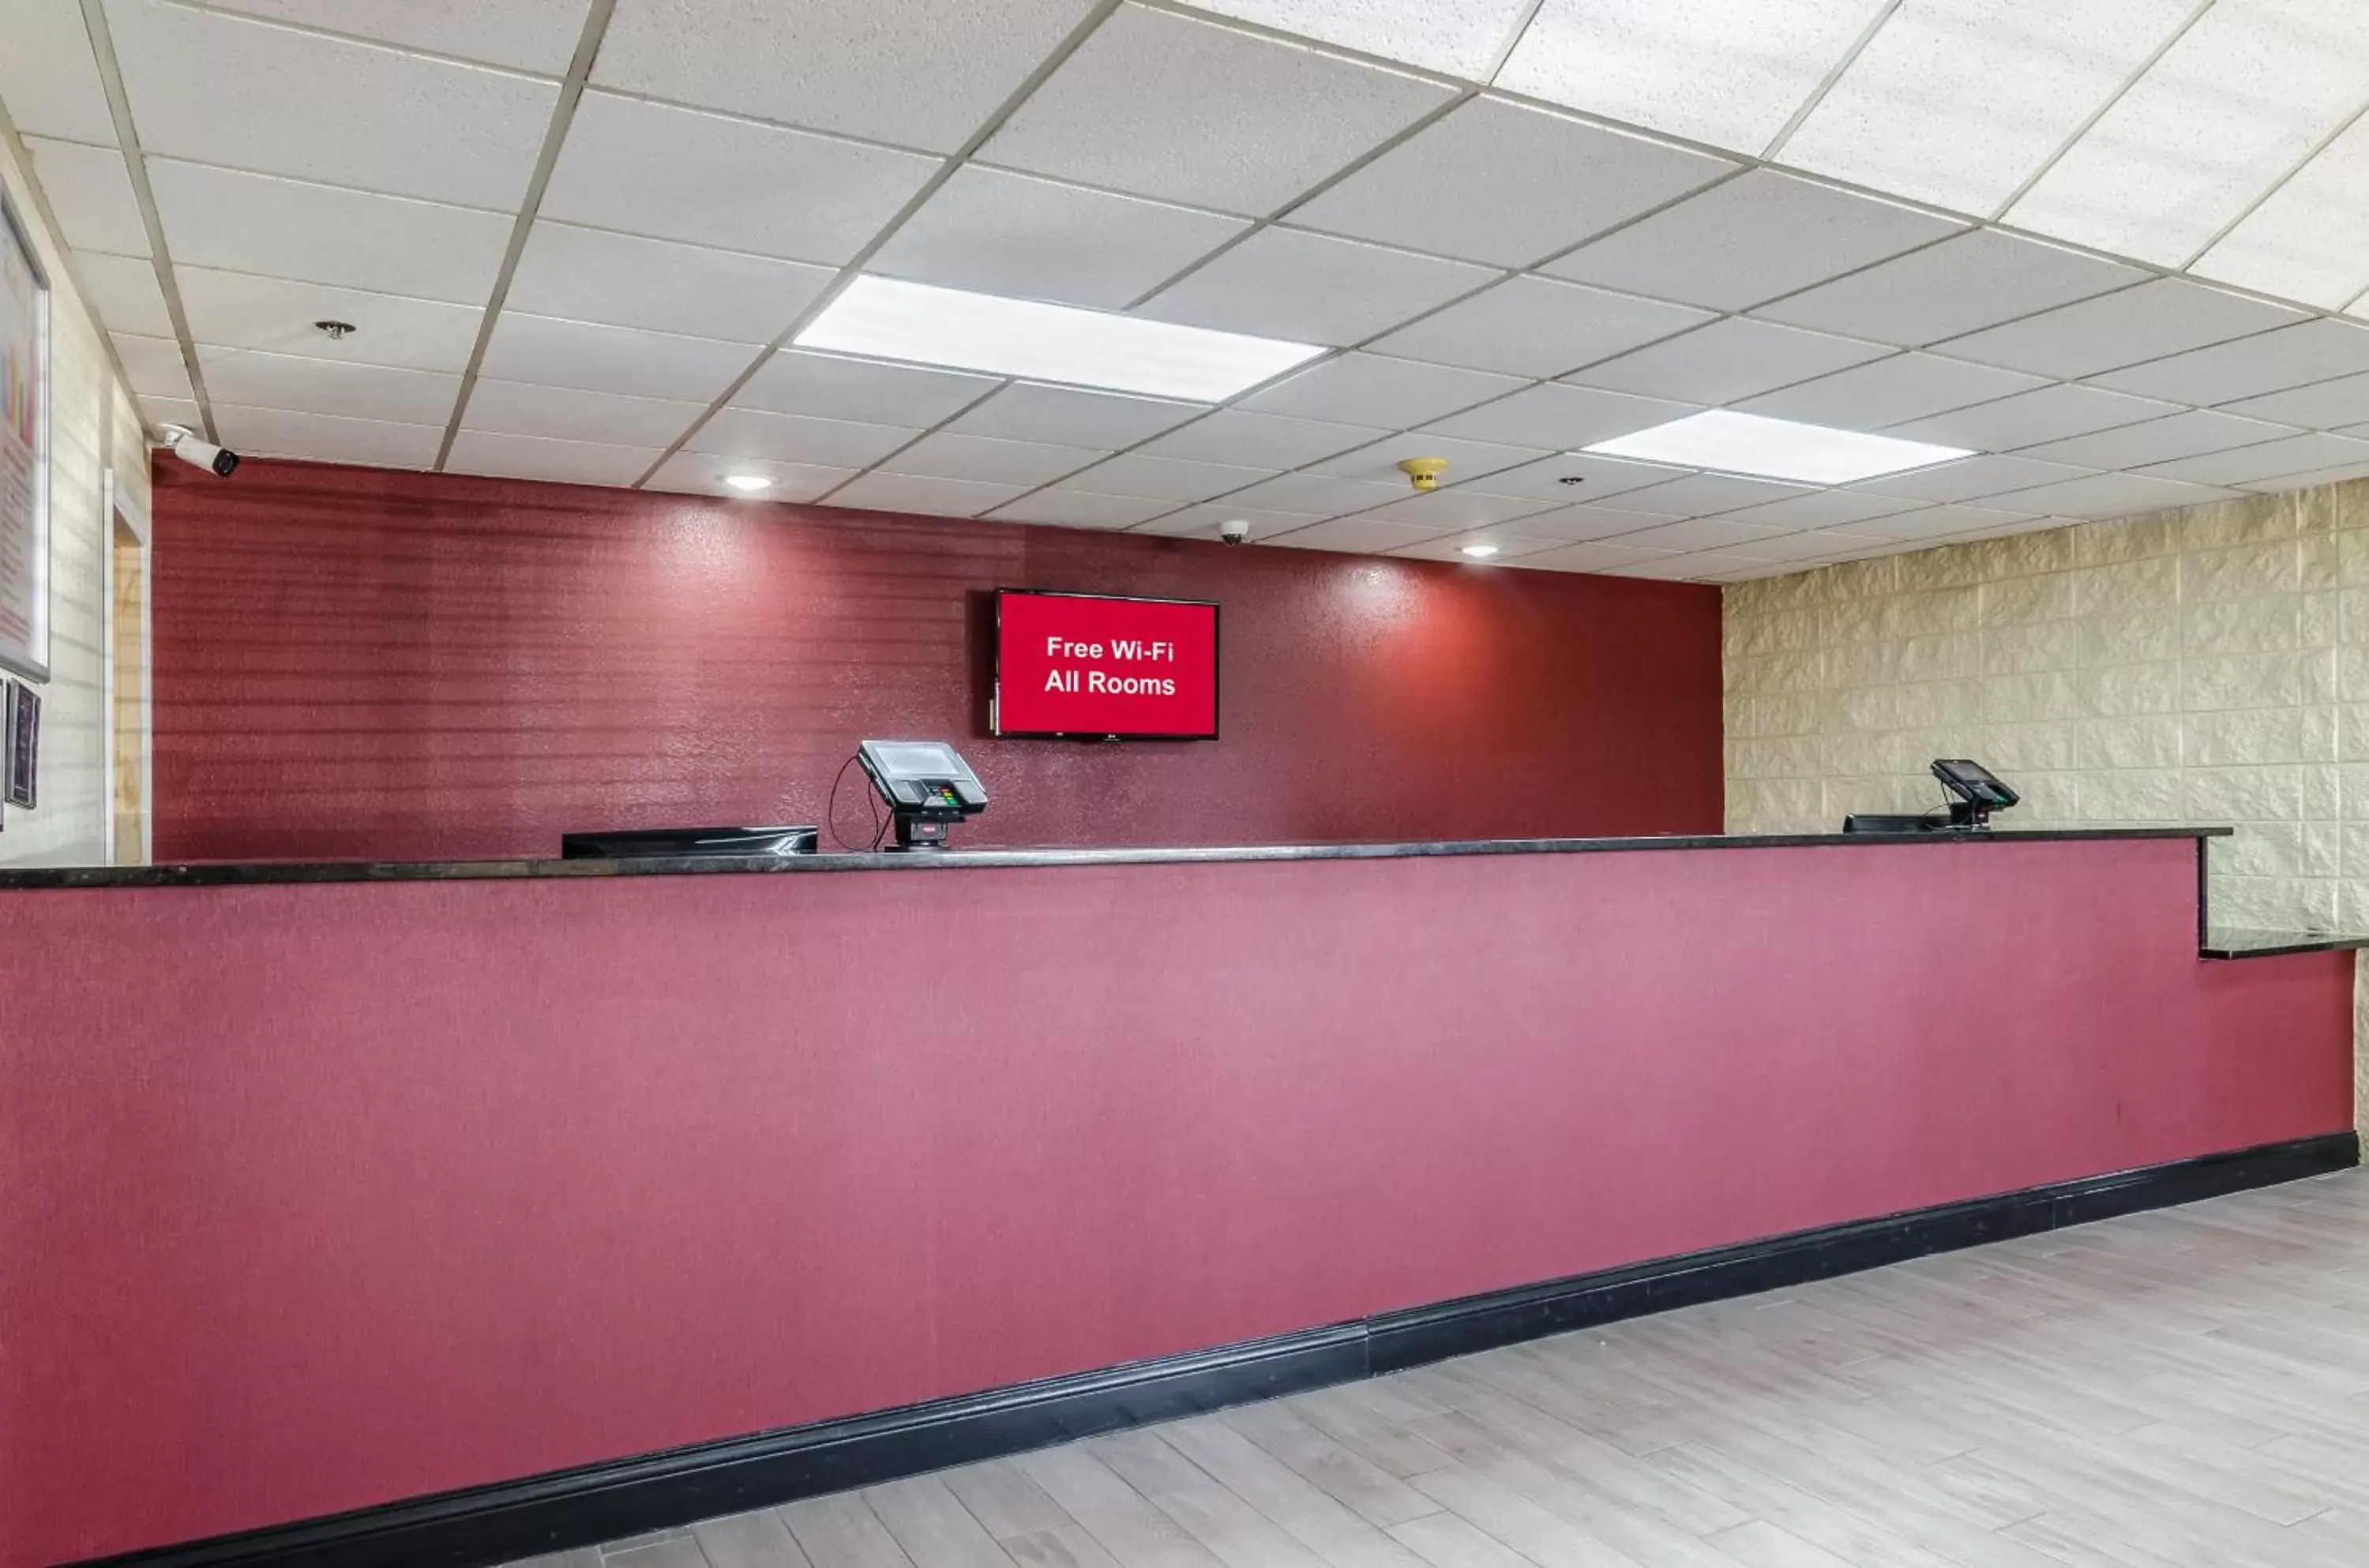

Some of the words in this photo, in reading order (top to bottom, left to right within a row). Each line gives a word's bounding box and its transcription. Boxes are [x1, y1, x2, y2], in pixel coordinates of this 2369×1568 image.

[1047, 636, 1103, 658] Free
[1111, 640, 1174, 662] Wi-Fi
[1045, 670, 1079, 692] All
[1088, 670, 1176, 696] Rooms
